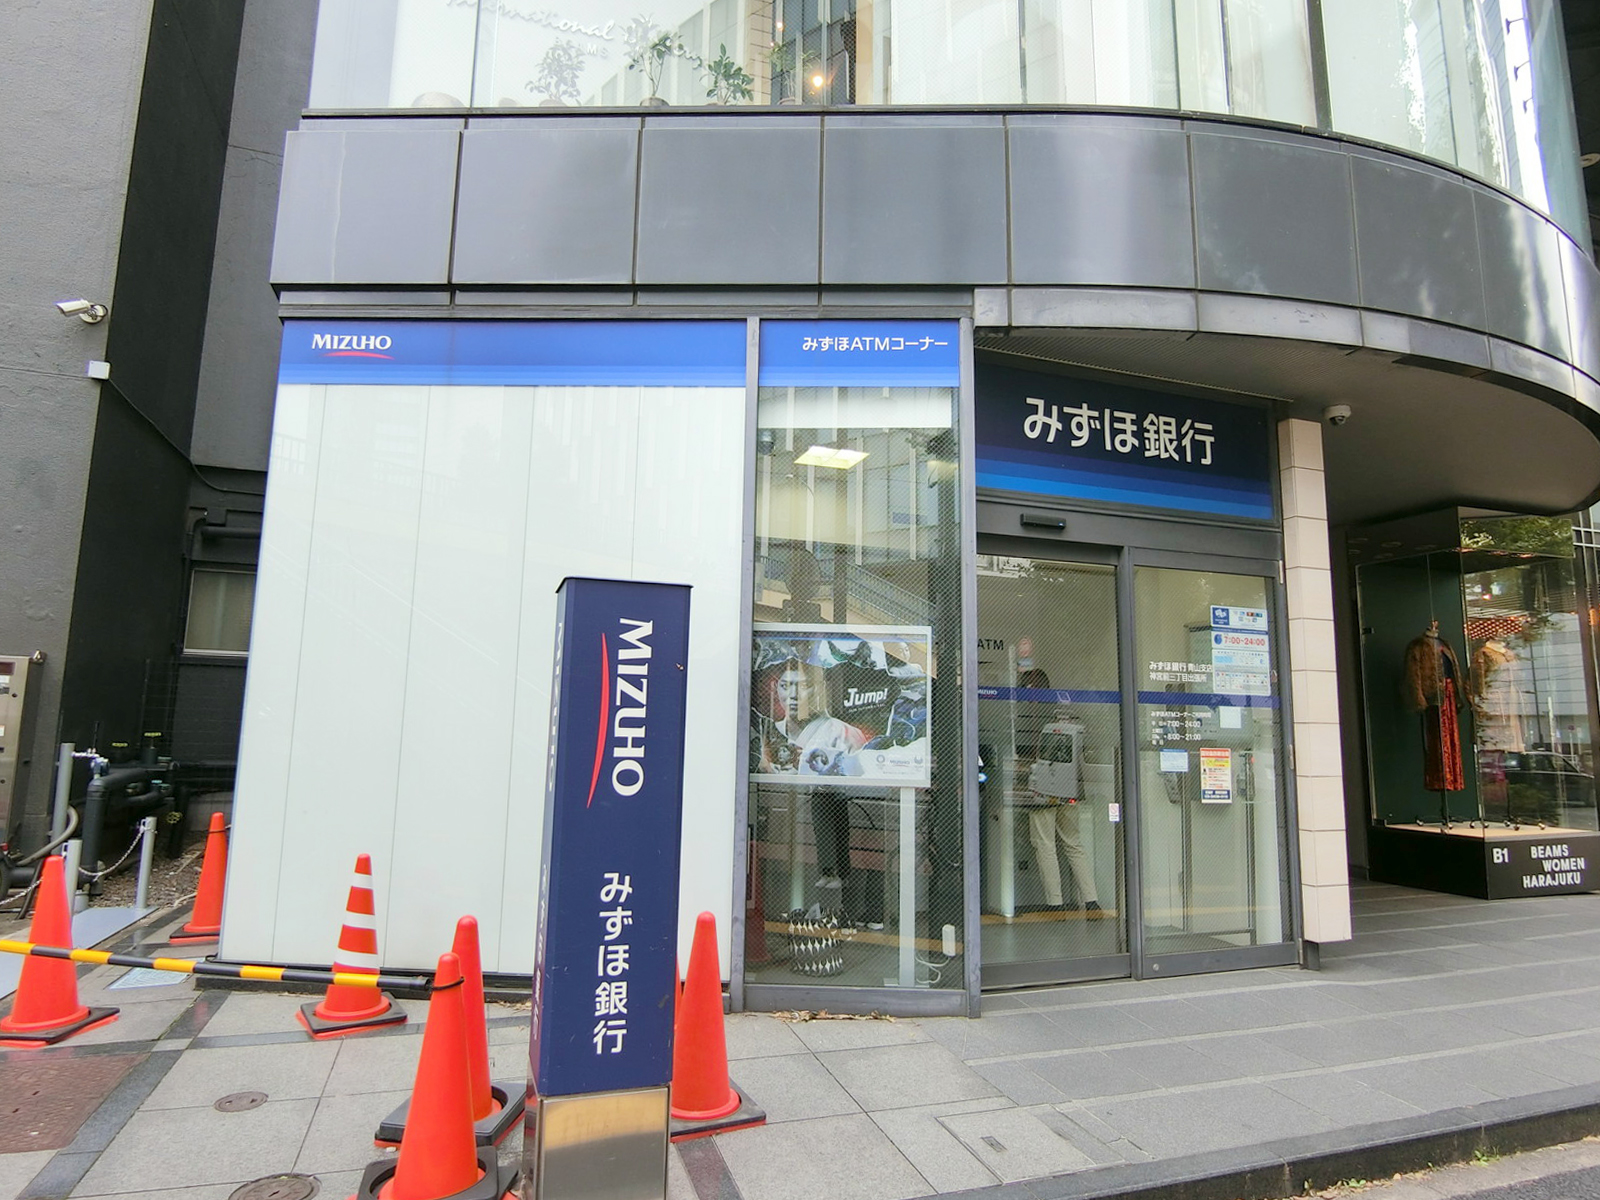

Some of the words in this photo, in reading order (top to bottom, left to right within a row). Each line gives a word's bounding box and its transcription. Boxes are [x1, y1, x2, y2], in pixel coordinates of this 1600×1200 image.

[311, 333, 392, 350] MIZUHO
[802, 336, 948, 351] みずほATMコーナー
[1023, 397, 1215, 465] みずほ銀行
[977, 638, 1004, 650] ATM
[843, 687, 889, 707] Jump!
[611, 617, 654, 797] MIZUHO
[1492, 847, 1510, 863] B1
[1529, 844, 1569, 859] BEAMS
[1541, 858, 1585, 872] WOMEN
[1522, 872, 1581, 888] HARAJUKU
[592, 872, 633, 1054] みずほ銀行
